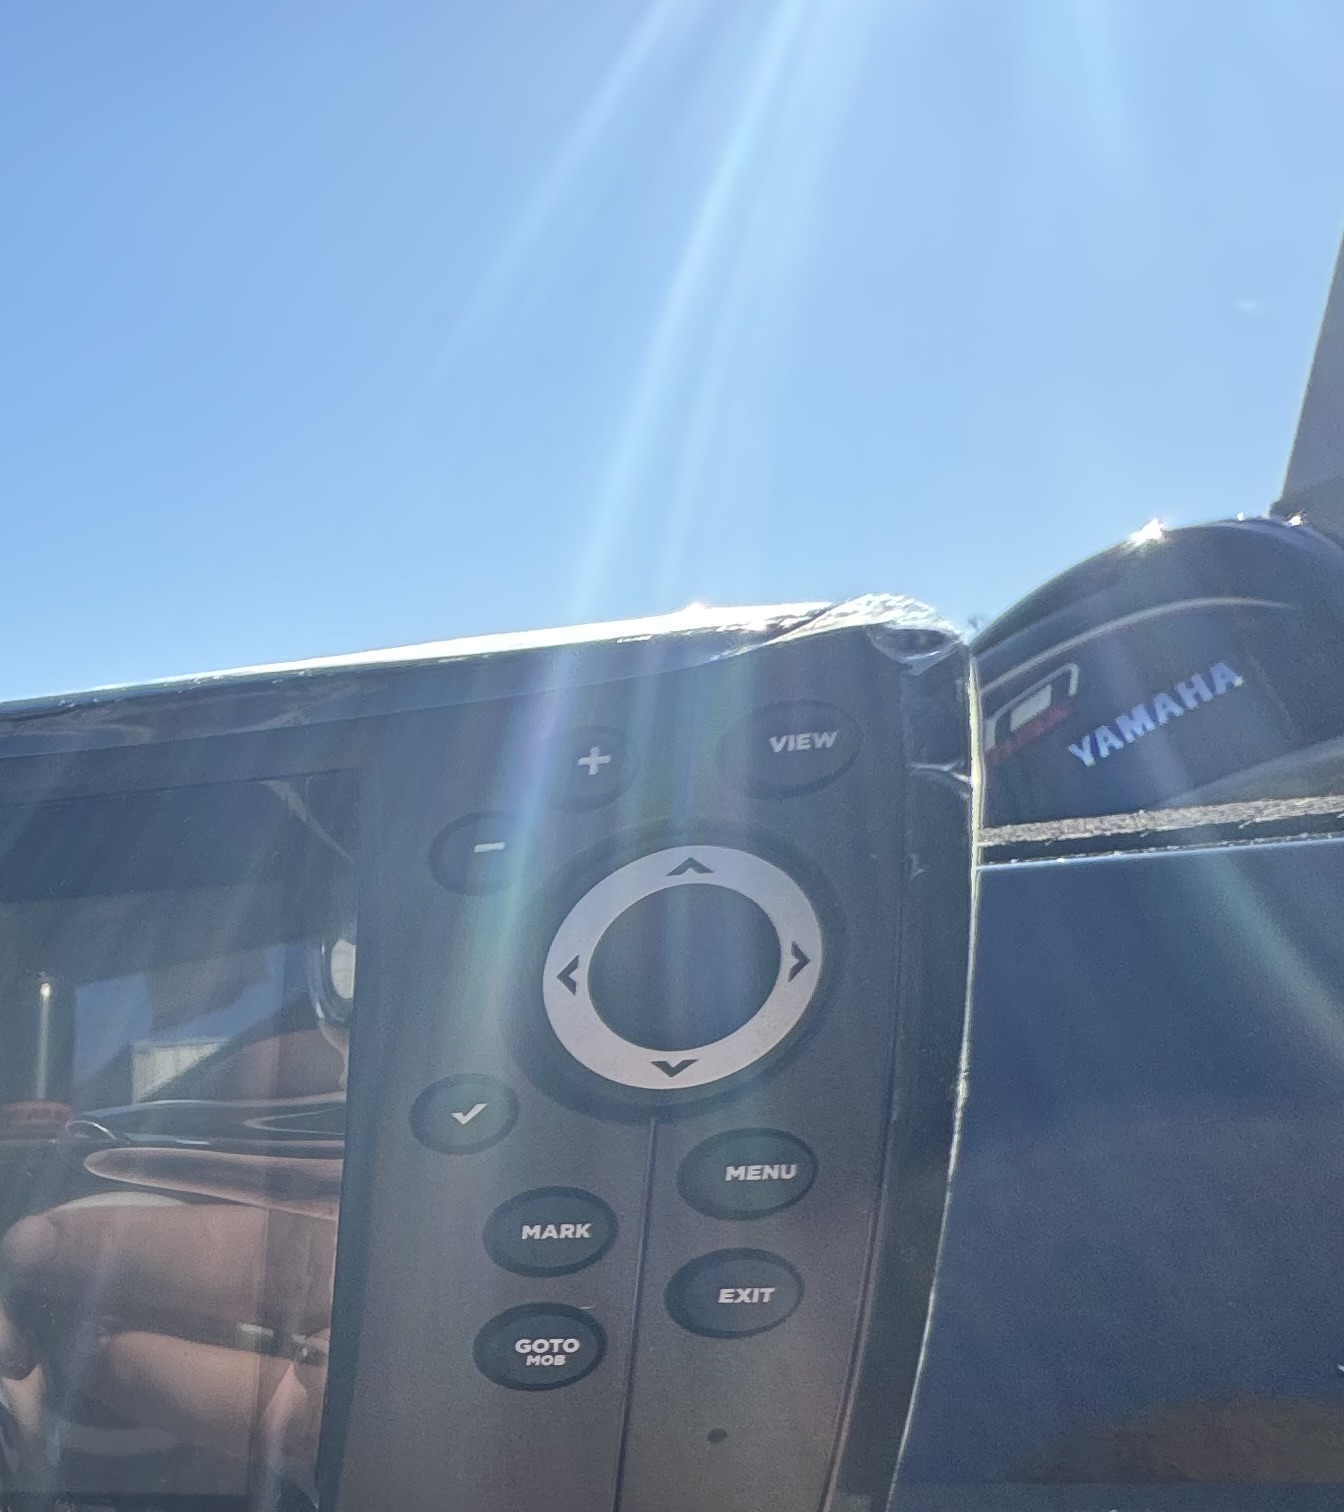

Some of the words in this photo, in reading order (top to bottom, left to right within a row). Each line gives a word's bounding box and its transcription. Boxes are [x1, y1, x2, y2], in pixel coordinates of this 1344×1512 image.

[1066, 661, 1245, 768] YAMAHA
[769, 730, 839, 753] VIEW
[724, 1164, 797, 1181] MENU
[521, 1223, 592, 1240] MARK
[718, 1287, 776, 1304] EXIT
[514, 1338, 580, 1354] GOTO
[525, 1354, 567, 1367] MOB
